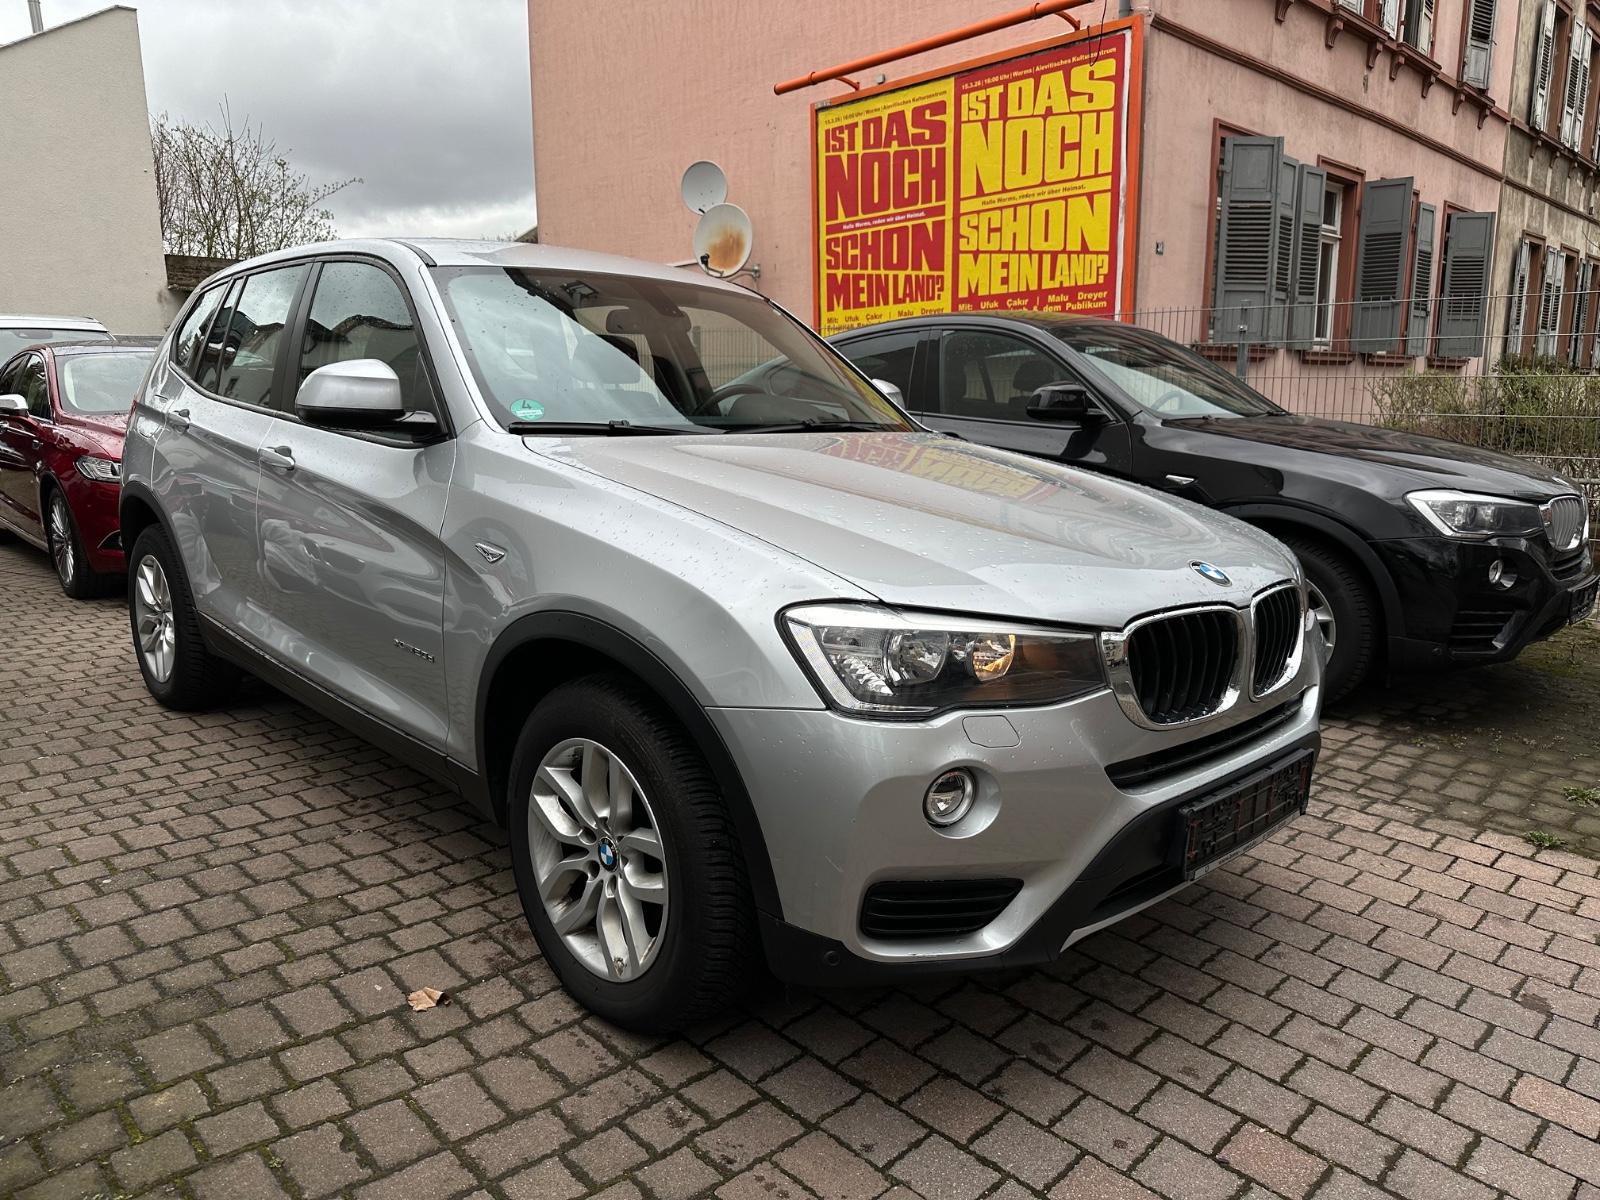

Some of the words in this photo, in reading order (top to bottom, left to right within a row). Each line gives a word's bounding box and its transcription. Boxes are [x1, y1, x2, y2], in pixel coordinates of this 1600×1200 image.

[961, 85, 1004, 121] IST
[1007, 58, 1116, 118] DAS
[1013, 68, 1032, 78] Worms
[825, 121, 858, 153] IST
[862, 100, 946, 150] DAS
[960, 110, 1114, 198] NOCH
[825, 147, 946, 220] NOCH
[1062, 184, 1086, 193] Heimat.
[959, 192, 1111, 251] SCHON
[826, 219, 944, 271] SCHON
[826, 273, 889, 312] MEIN
[893, 274, 944, 305] LAND?
[958, 253, 1039, 298] MEIN
[1042, 253, 1109, 289] LAND?
[844, 315, 860, 323] Ufuk
[897, 310, 914, 318] Malu
[920, 307, 944, 316] Dreyer
[958, 303, 973, 311] Mit:
[980, 301, 999, 310] Ufuk
[1048, 294, 1069, 303] Malu
[1077, 290, 1108, 301] Dreyer
[1043, 304, 1062, 312] dem
[1066, 301, 1107, 311] Publikum
[521, 399, 533, 410] 4
